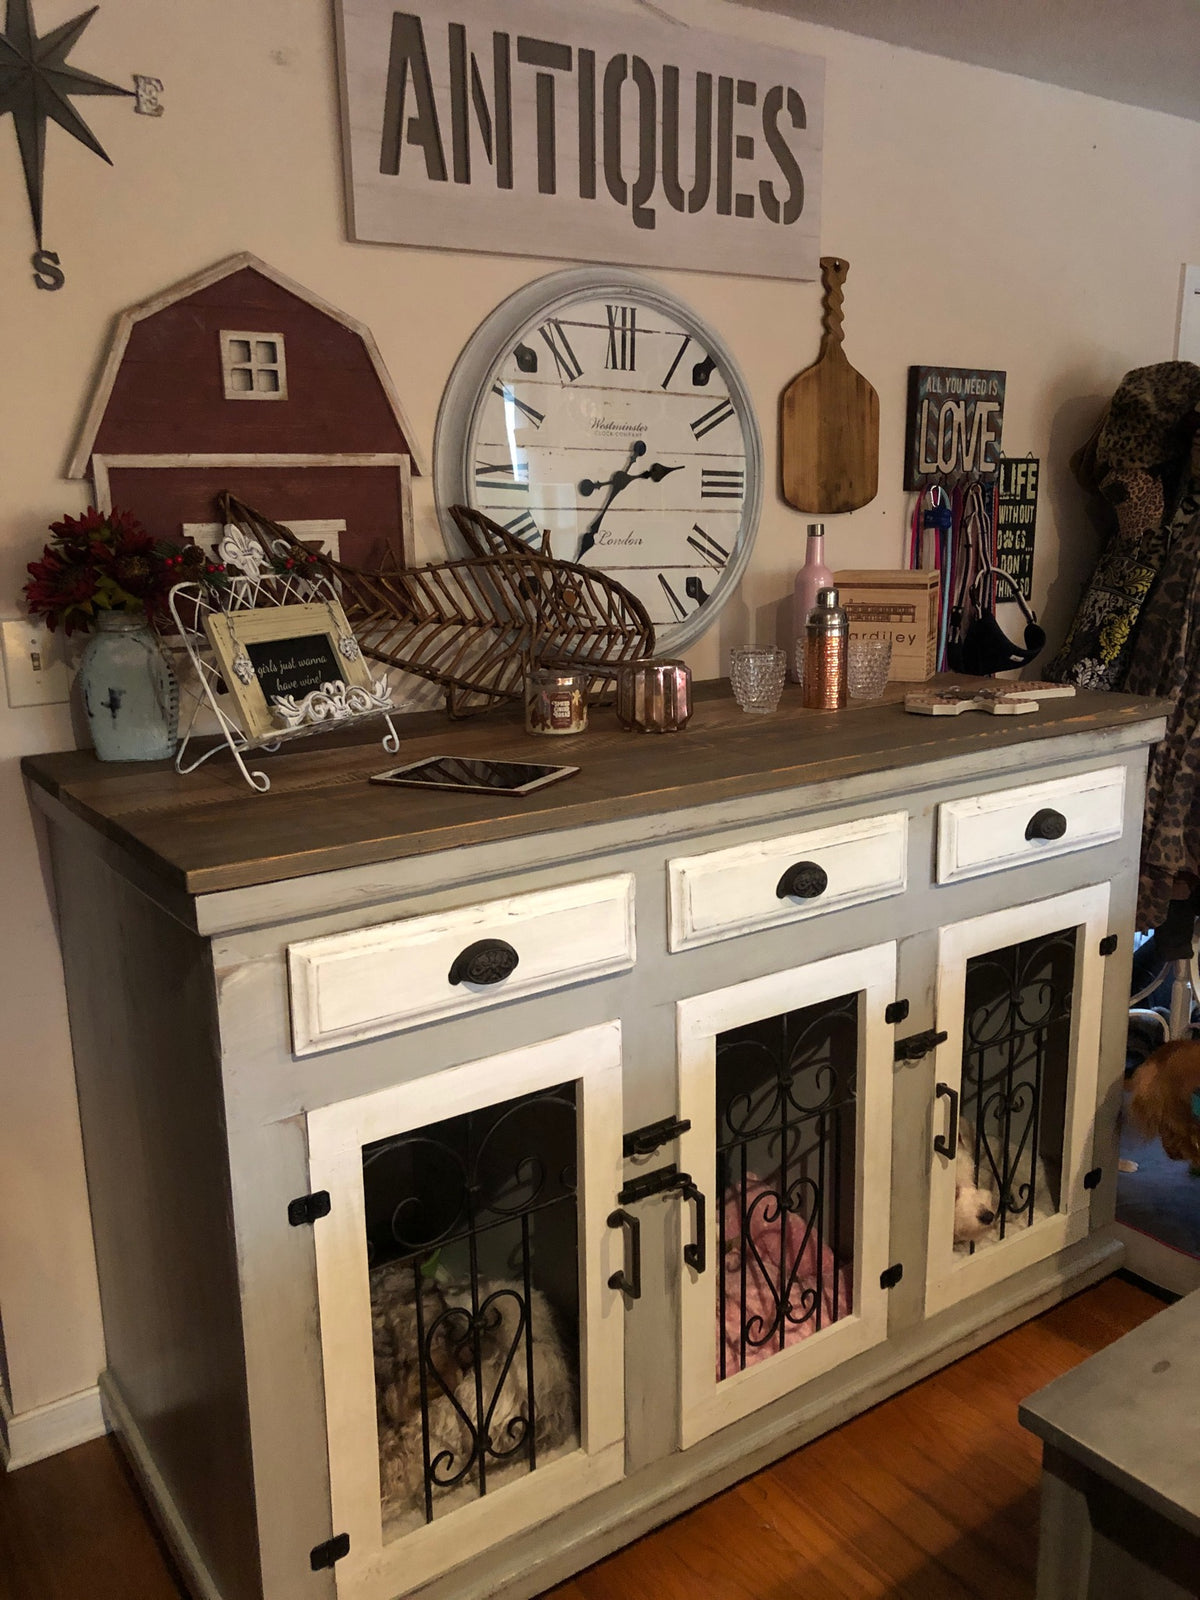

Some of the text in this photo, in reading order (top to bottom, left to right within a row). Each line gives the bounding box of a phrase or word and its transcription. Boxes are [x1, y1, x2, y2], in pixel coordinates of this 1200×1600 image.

[132, 74, 164, 117] E
[379, 11, 806, 229] ANTIQUES
[32, 249, 65, 292] S
[925, 376, 998, 396] ALL YOU NEED IS
[591, 417, 648, 431] Westminster
[918, 398, 1000, 474] LOVE
[999, 462, 1037, 499] LIFE
[998, 504, 1034, 524] WITHOUT
[599, 529, 642, 546] London
[1000, 554, 1030, 574] DON'T
[257, 655, 327, 678] girls just wanna
[276, 669, 322, 691] have wine!
